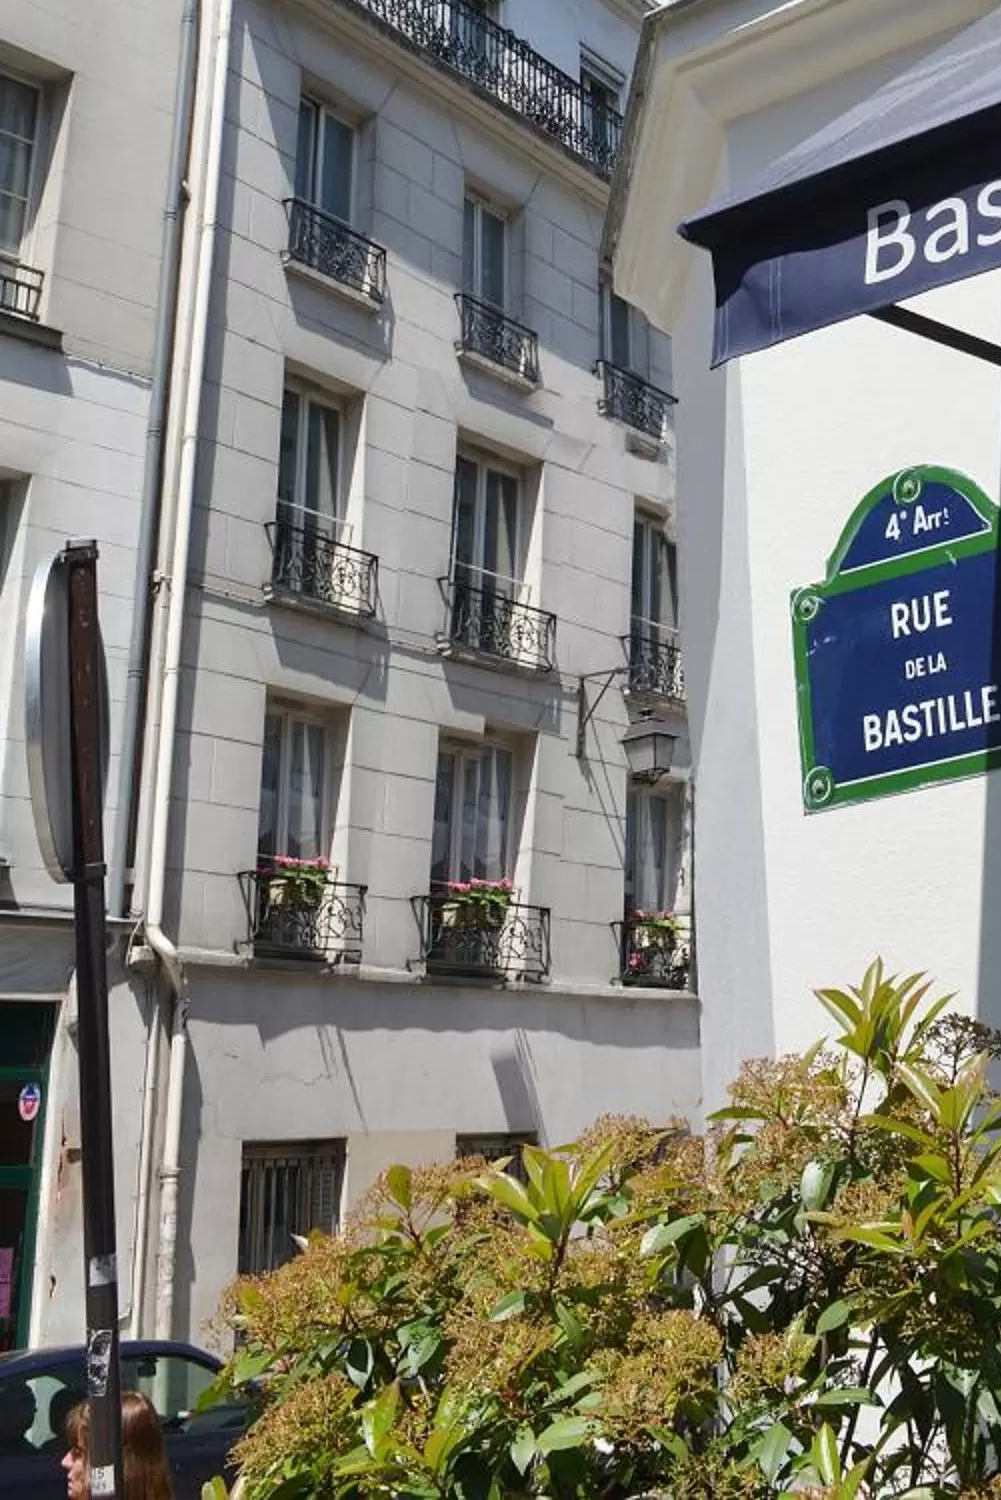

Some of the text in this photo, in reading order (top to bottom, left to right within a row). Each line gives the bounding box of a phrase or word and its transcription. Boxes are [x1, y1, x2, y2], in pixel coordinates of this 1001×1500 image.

[891, 589, 953, 639] RUE
[904, 651, 948, 681] DE LA
[863, 685, 1001, 753] BASTILLE
